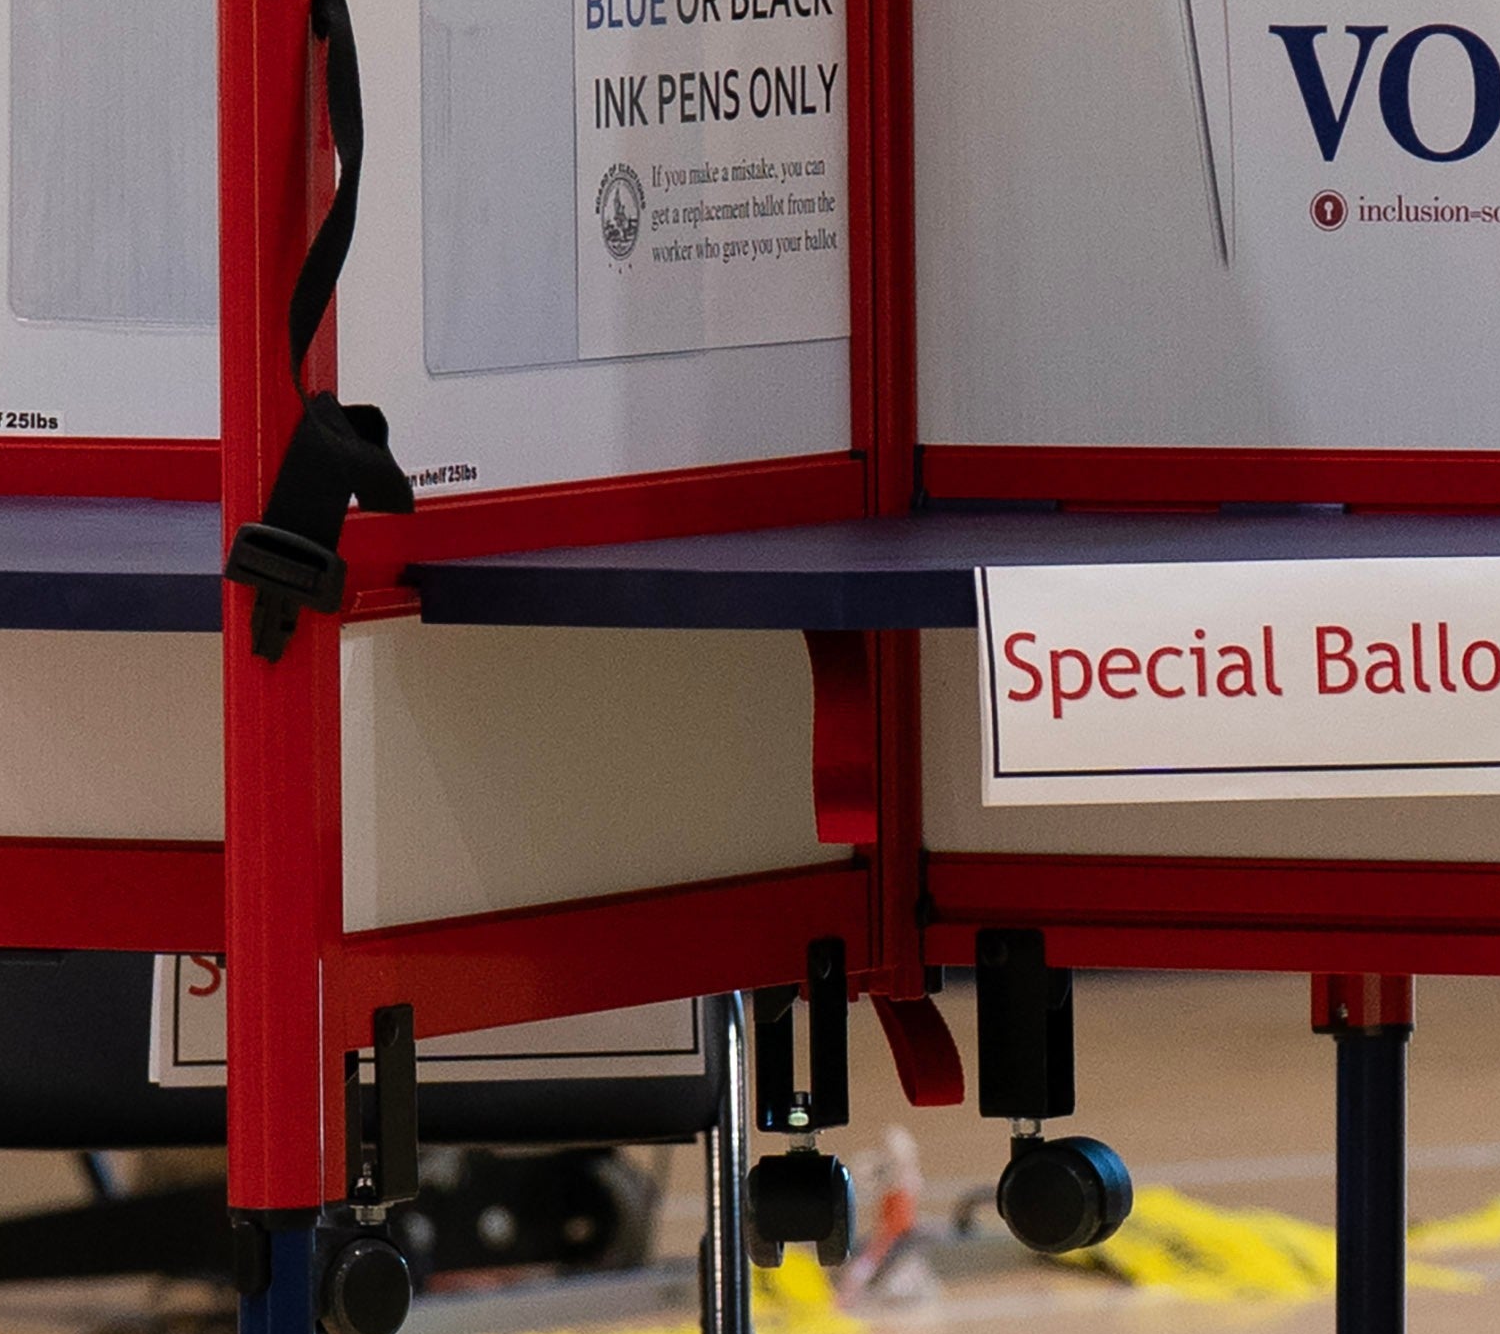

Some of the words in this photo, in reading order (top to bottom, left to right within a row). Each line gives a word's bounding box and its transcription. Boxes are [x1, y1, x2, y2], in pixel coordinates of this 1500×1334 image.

[595, 76, 648, 128] INK
[658, 69, 740, 124] PENS
[749, 63, 838, 118] ONLY
[652, 164, 662, 188] If
[664, 170, 686, 191] you
[689, 162, 719, 185] make
[721, 166, 729, 182] a
[731, 157, 779, 181] mistake,
[781, 161, 802, 184] you
[805, 160, 825, 176] can
[651, 207, 670, 230] get
[672, 208, 680, 224] a
[682, 199, 750, 227] replacement
[752, 194, 785, 218] ballot
[787, 193, 816, 215] from
[817, 190, 836, 213] the
[652, 239, 694, 262] worker
[696, 236, 720, 259] who
[723, 240, 749, 262] gave
[752, 239, 773, 260] you
[776, 236, 802, 259] your
[804, 228, 838, 251] ballot
[6, 413, 58, 430] 25lbs
[448, 464, 477, 483] 25lbs
[1004, 625, 1283, 719] Special
